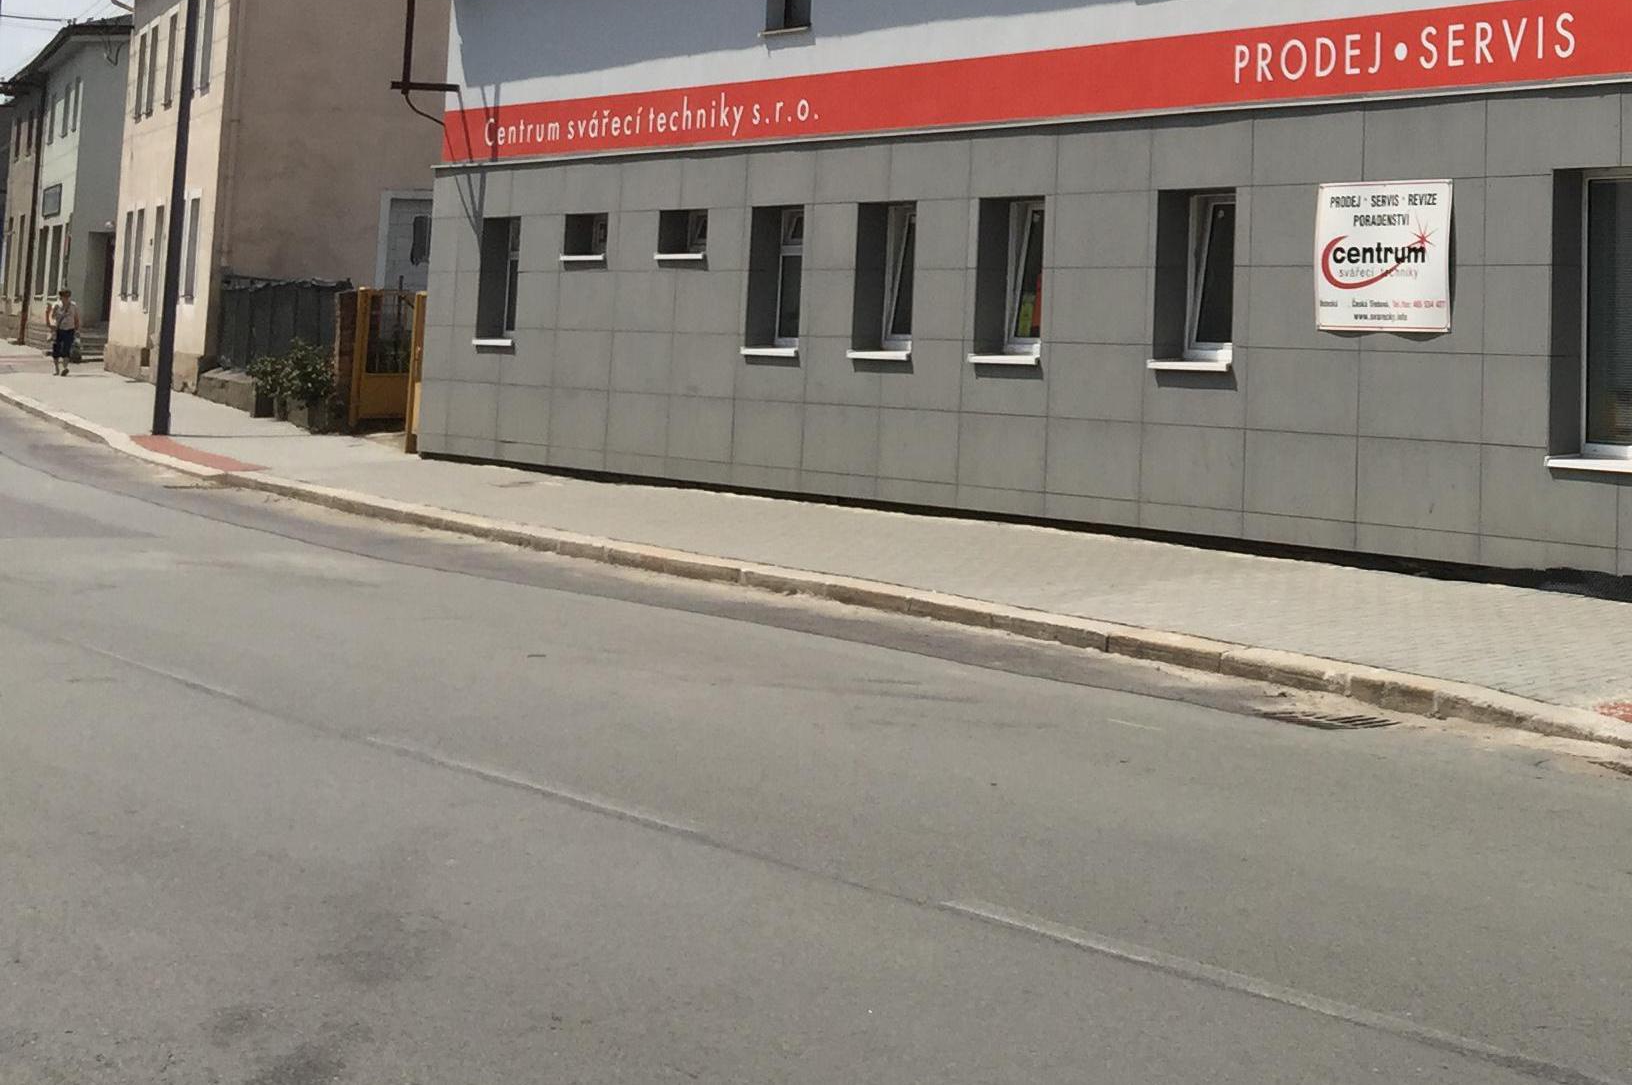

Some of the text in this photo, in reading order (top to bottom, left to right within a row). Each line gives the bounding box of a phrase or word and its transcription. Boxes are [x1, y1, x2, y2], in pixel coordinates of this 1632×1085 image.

[1234, 12, 1576, 84] PRODEJ SERVIS
[484, 117, 561, 147] Centrum
[566, 106, 642, 140] svářecí
[648, 92, 744, 137] techniky
[1330, 192, 1438, 208] PRODEJ SERVIS REVIZE
[1332, 242, 1425, 264] centrum
